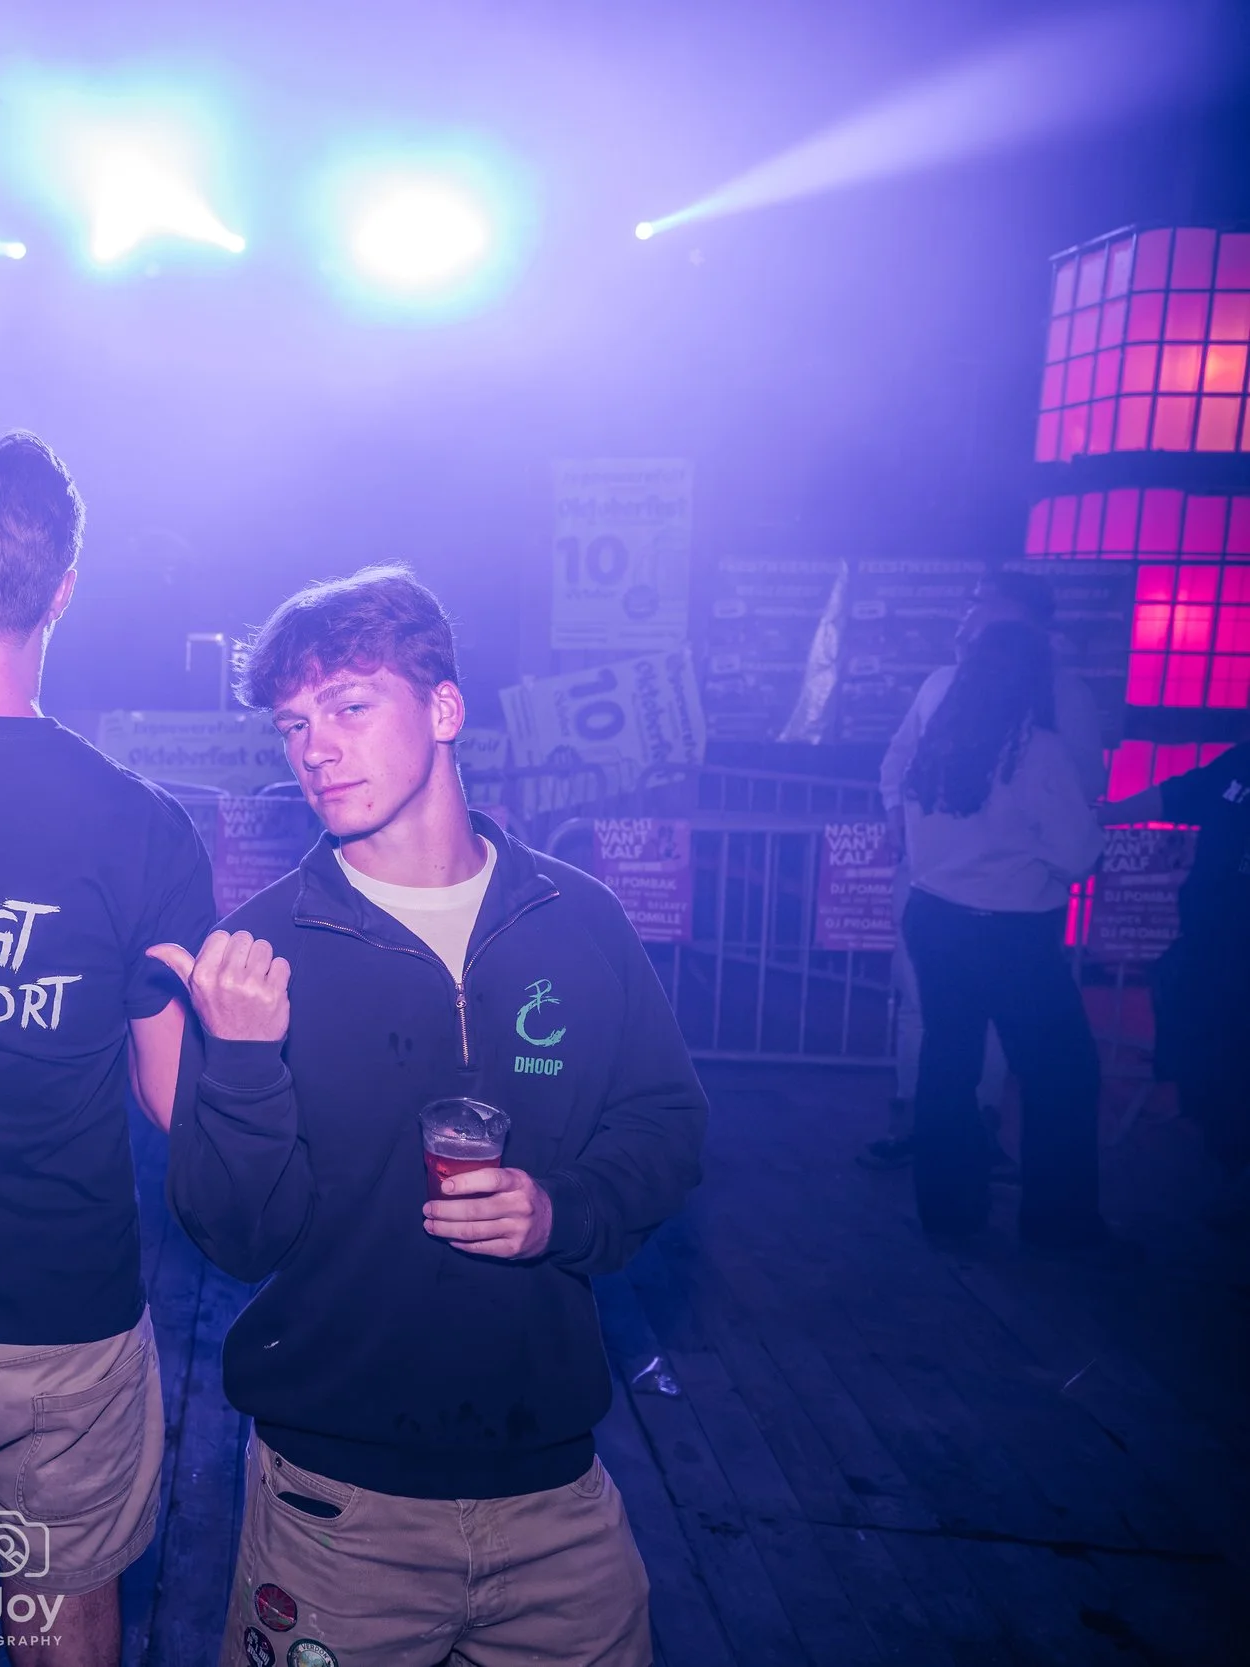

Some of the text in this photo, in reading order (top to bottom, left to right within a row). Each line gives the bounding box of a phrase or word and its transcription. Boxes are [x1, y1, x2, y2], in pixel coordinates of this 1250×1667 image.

[556, 535, 628, 585] 10
[568, 667, 626, 741] 10
[593, 818, 653, 832] NACHT
[824, 821, 886, 838] NACHT
[601, 845, 643, 859] KALF
[829, 849, 874, 866] KALF
[1102, 856, 1149, 873] KALF
[514, 1056, 564, 1076] DHOOP
